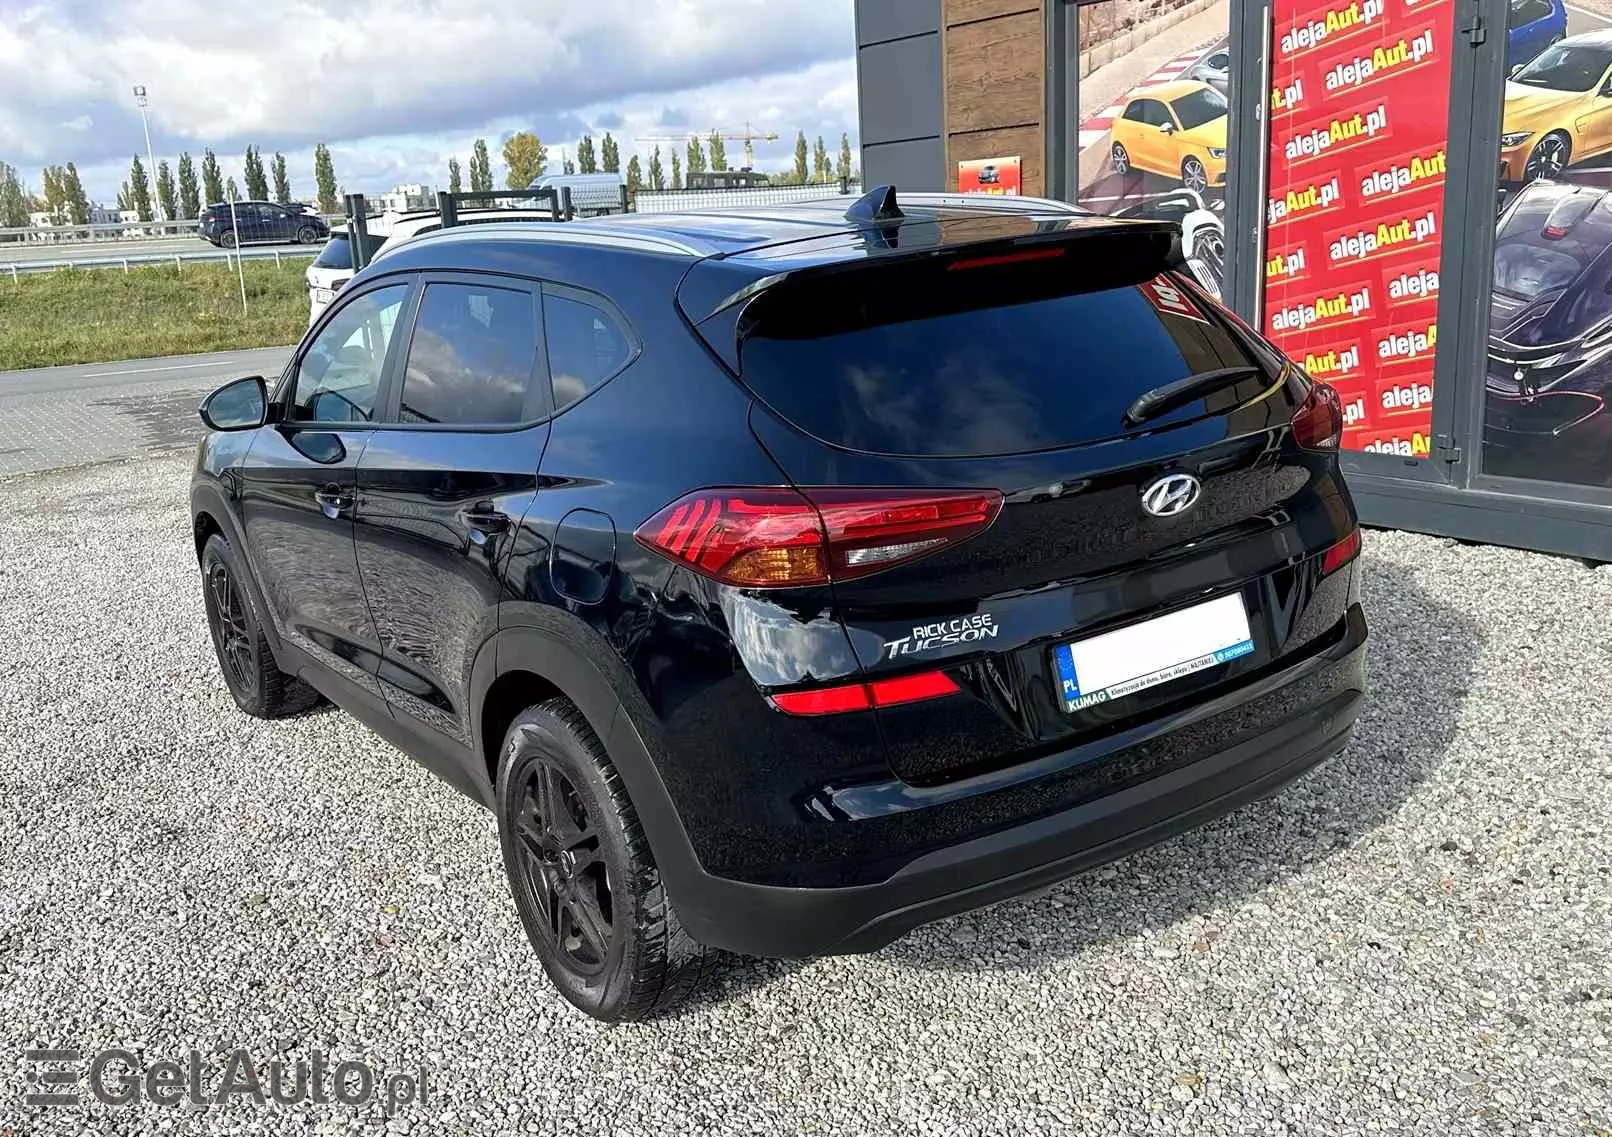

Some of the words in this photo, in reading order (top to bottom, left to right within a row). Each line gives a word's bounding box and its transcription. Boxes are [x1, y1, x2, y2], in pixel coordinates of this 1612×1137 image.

[1280, 0, 1384, 53] alejaAut.pl
[1325, 29, 1433, 90] alejaAut.pl
[1284, 104, 1387, 159] alejaAut.pl
[1329, 212, 1436, 260] alejaAut.pl
[1388, 269, 1440, 299] aleja
[1271, 288, 1371, 330] alejaAut.pl
[883, 624, 999, 660] TUCSON
[912, 622, 948, 640] RICK
[950, 613, 993, 632] CASE
[1063, 678, 1078, 693] PL
[1069, 690, 1106, 712] KLIMAG
